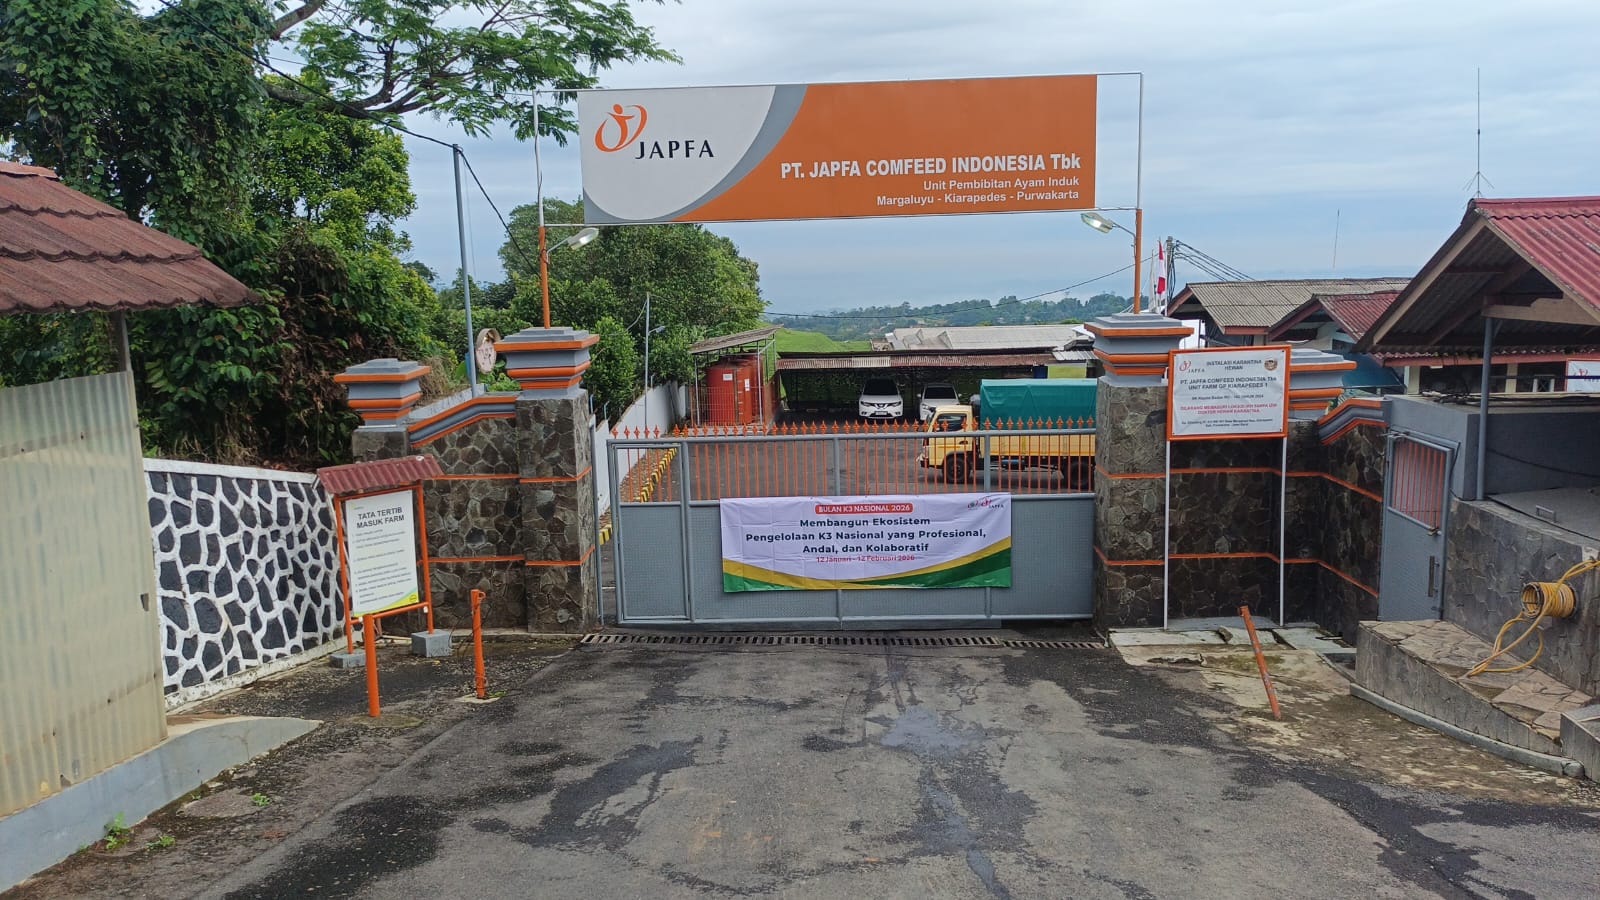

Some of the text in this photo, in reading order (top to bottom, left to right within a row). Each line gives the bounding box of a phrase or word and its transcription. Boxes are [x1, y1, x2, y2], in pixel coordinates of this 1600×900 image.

[634, 139, 714, 160] JAPFA
[781, 152, 1081, 179] PT. JAPFA COMFEED INDONESIA Tbk
[923, 176, 1080, 191] Unit Pembibitan Ayam Induk
[877, 194, 935, 207] Margaluyu
[944, 193, 1007, 205] Kiarapedes
[1017, 190, 1079, 201] Purwakarta
[358, 506, 403, 520] TATA TERTIB
[819, 505, 841, 513] BULAN
[854, 503, 890, 512] NASIONAL
[891, 503, 911, 511] 2026
[356, 514, 405, 529] MASUK FARM
[800, 517, 930, 528] Membangun Ekosistem
[746, 529, 986, 543] Pengelolaan K3 Nasional yang Profesional,
[803, 543, 929, 554] Andal, dan Kolaboratif
